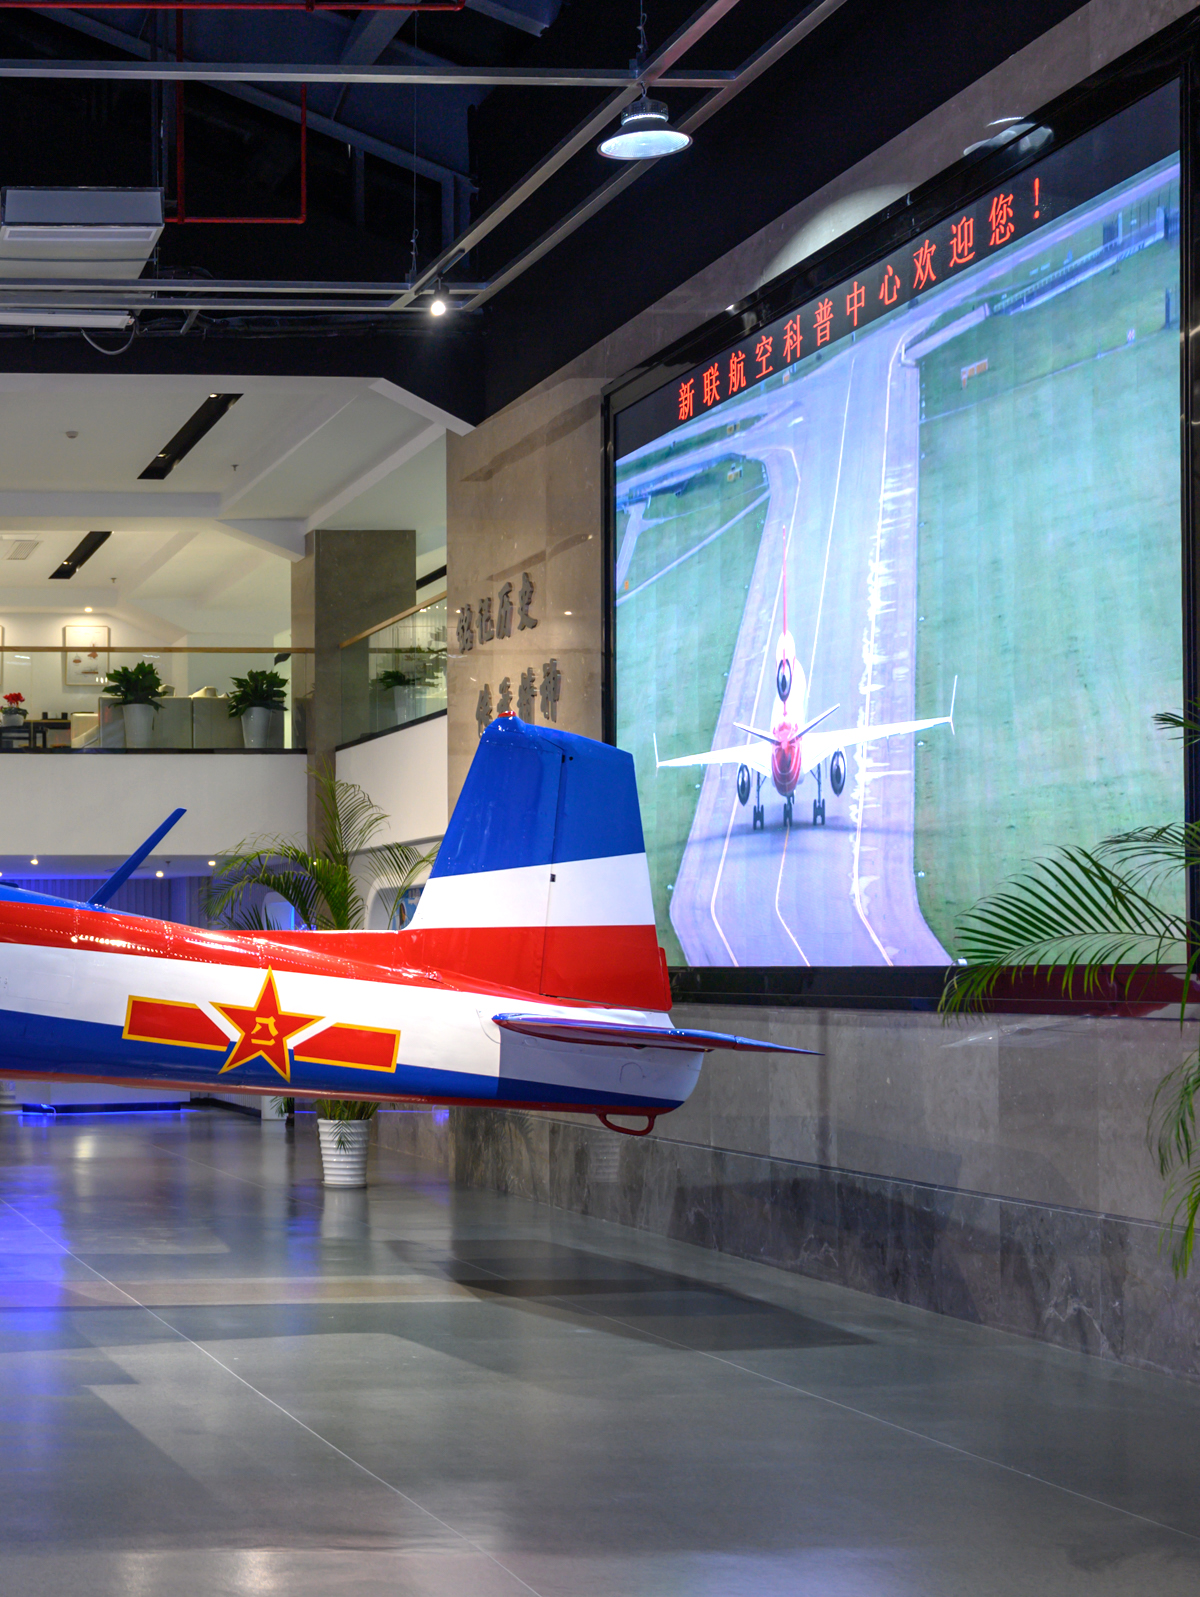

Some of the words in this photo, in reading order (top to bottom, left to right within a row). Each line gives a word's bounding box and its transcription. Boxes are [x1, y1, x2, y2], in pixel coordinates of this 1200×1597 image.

[678, 178, 1040, 421] 新联航空科普中心欢迎您！
[456, 572, 538, 654] 铭记历史
